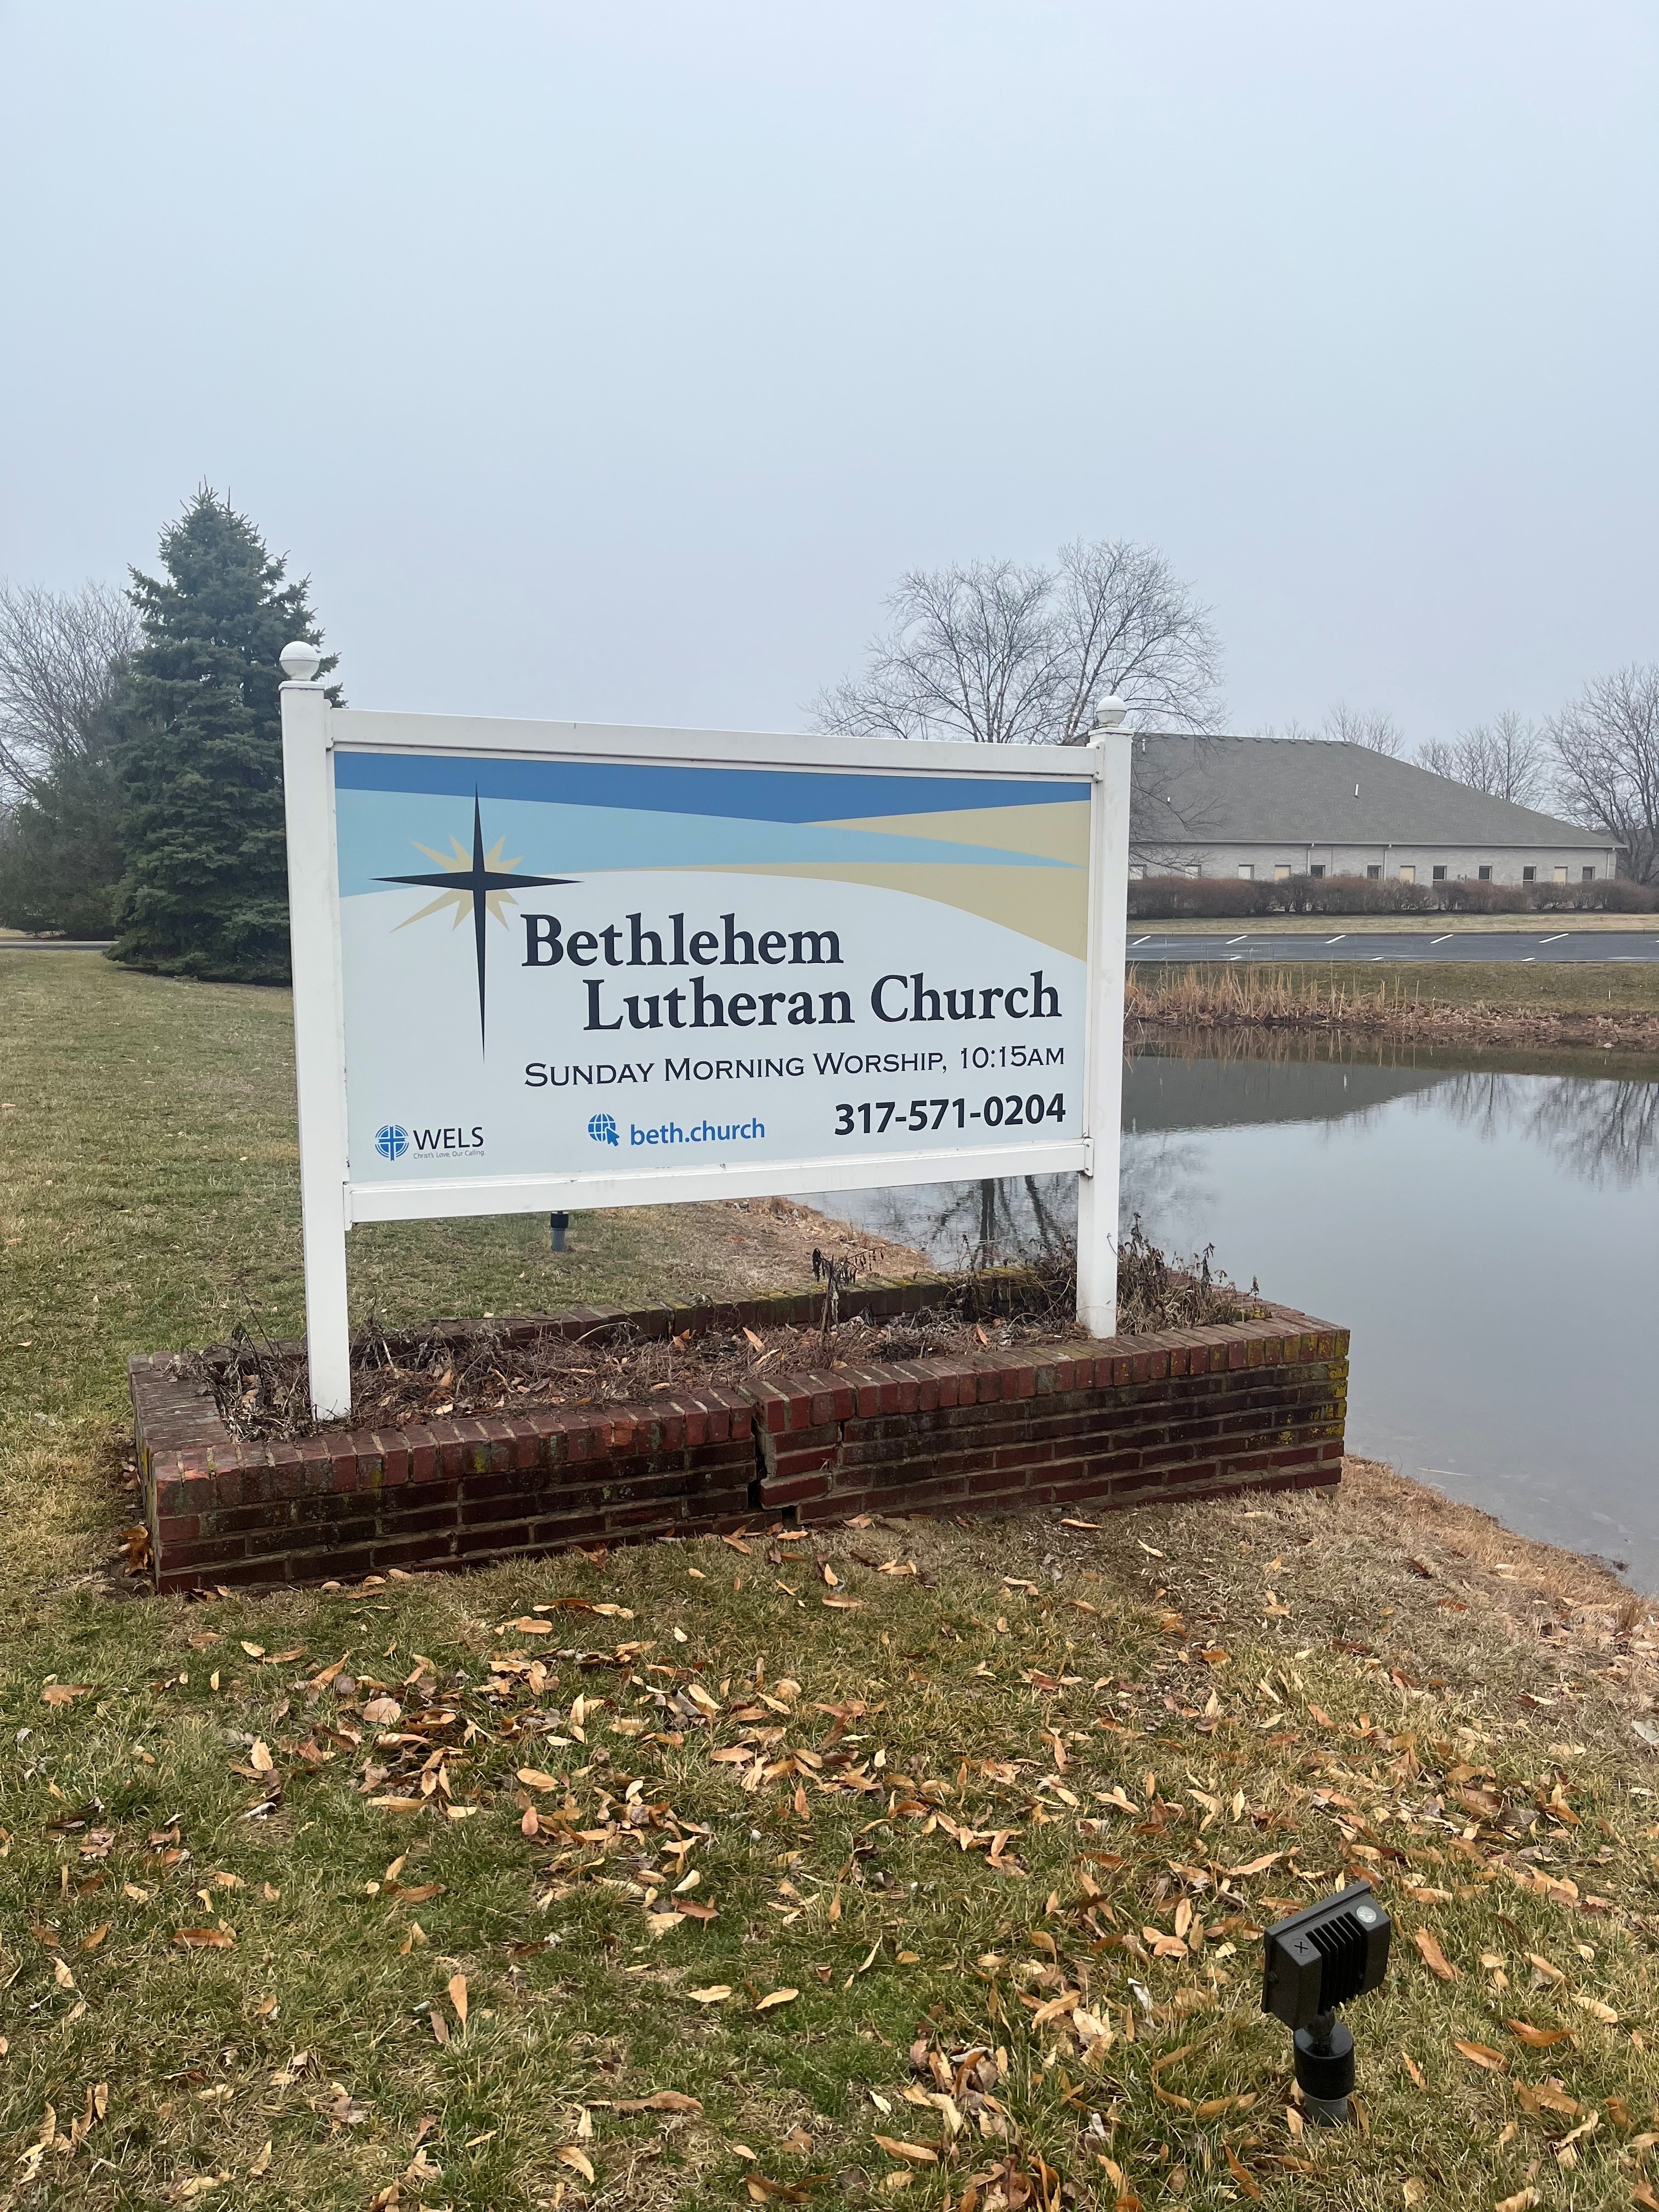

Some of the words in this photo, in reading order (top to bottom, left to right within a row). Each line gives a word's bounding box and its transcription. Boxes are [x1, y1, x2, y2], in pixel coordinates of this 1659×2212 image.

[520, 912, 844, 967] Bethlehem
[582, 975, 855, 1031] Lutheran
[871, 970, 1062, 1023] Church
[524, 1063, 655, 1087] SUNDAY
[664, 1057, 805, 1081] MORNING
[812, 1052, 947, 1075] WORSHIP,
[961, 1045, 1064, 1069] 10:15AM
[630, 1117, 765, 1146] beth.church
[834, 1093, 1066, 1136] 317-571-0204
[413, 1127, 484, 1150] WELS
